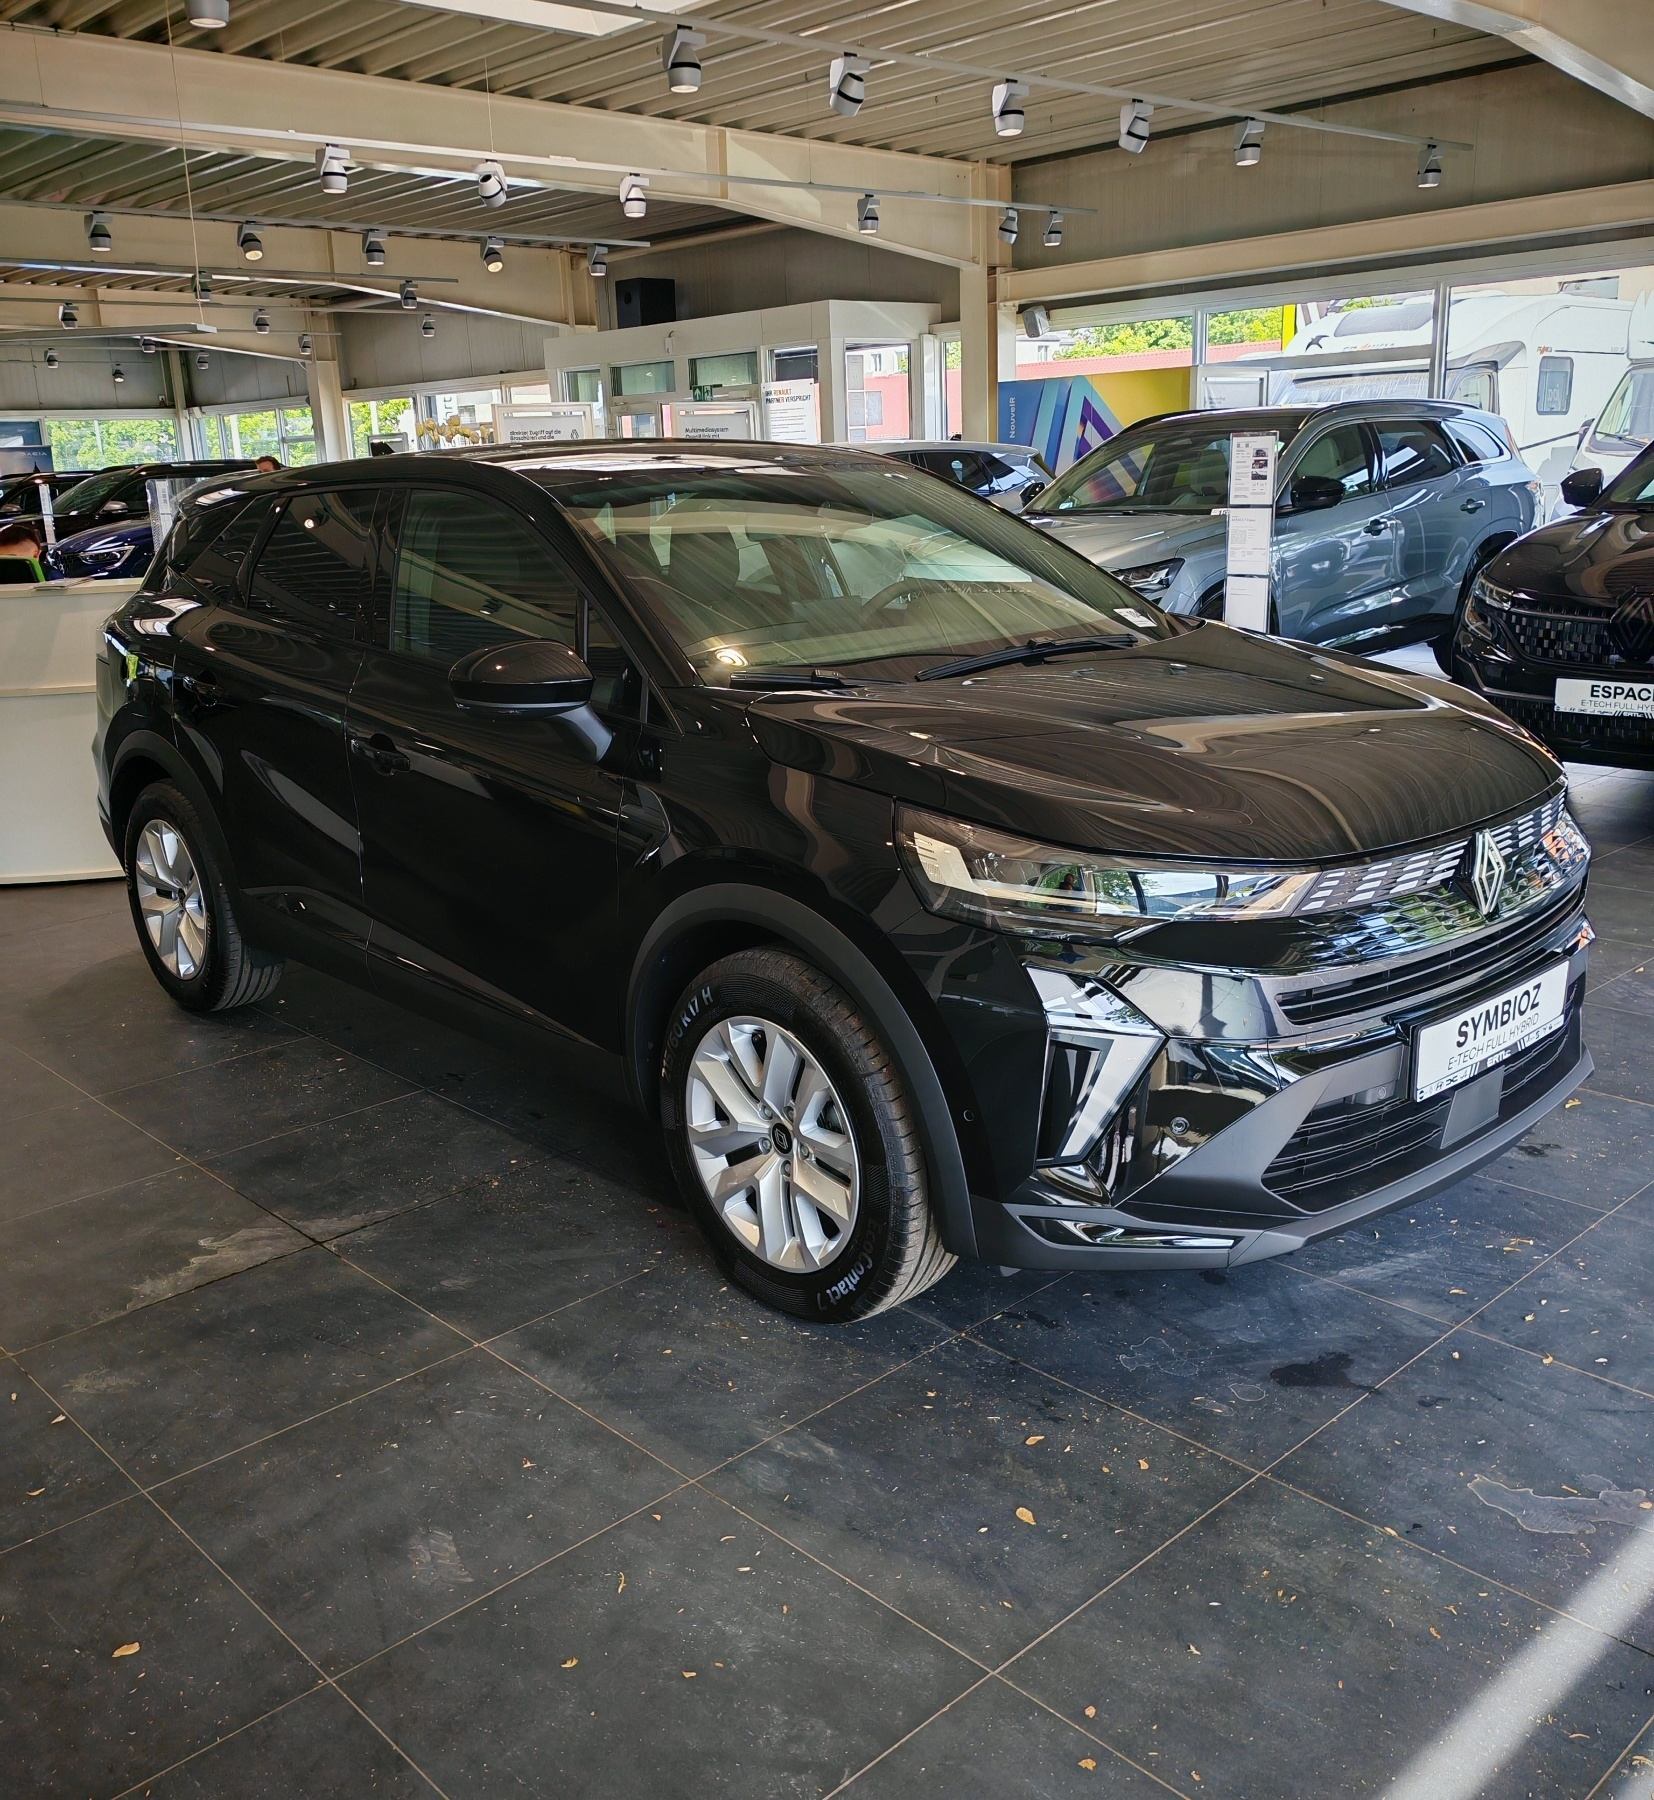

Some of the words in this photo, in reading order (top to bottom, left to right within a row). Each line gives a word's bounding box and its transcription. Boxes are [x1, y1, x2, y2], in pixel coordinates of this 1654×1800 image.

[1581, 699, 1612, 709] E-TECH
[1614, 701, 1633, 711] FULL
[1590, 684, 1654, 702] ESPAC
[1456, 982, 1542, 1048] SYMBIOZ
[1447, 1045, 1484, 1071] E-TECH
[1486, 1032, 1508, 1053] FULL
[1509, 1013, 1539, 1039] HYBRID
